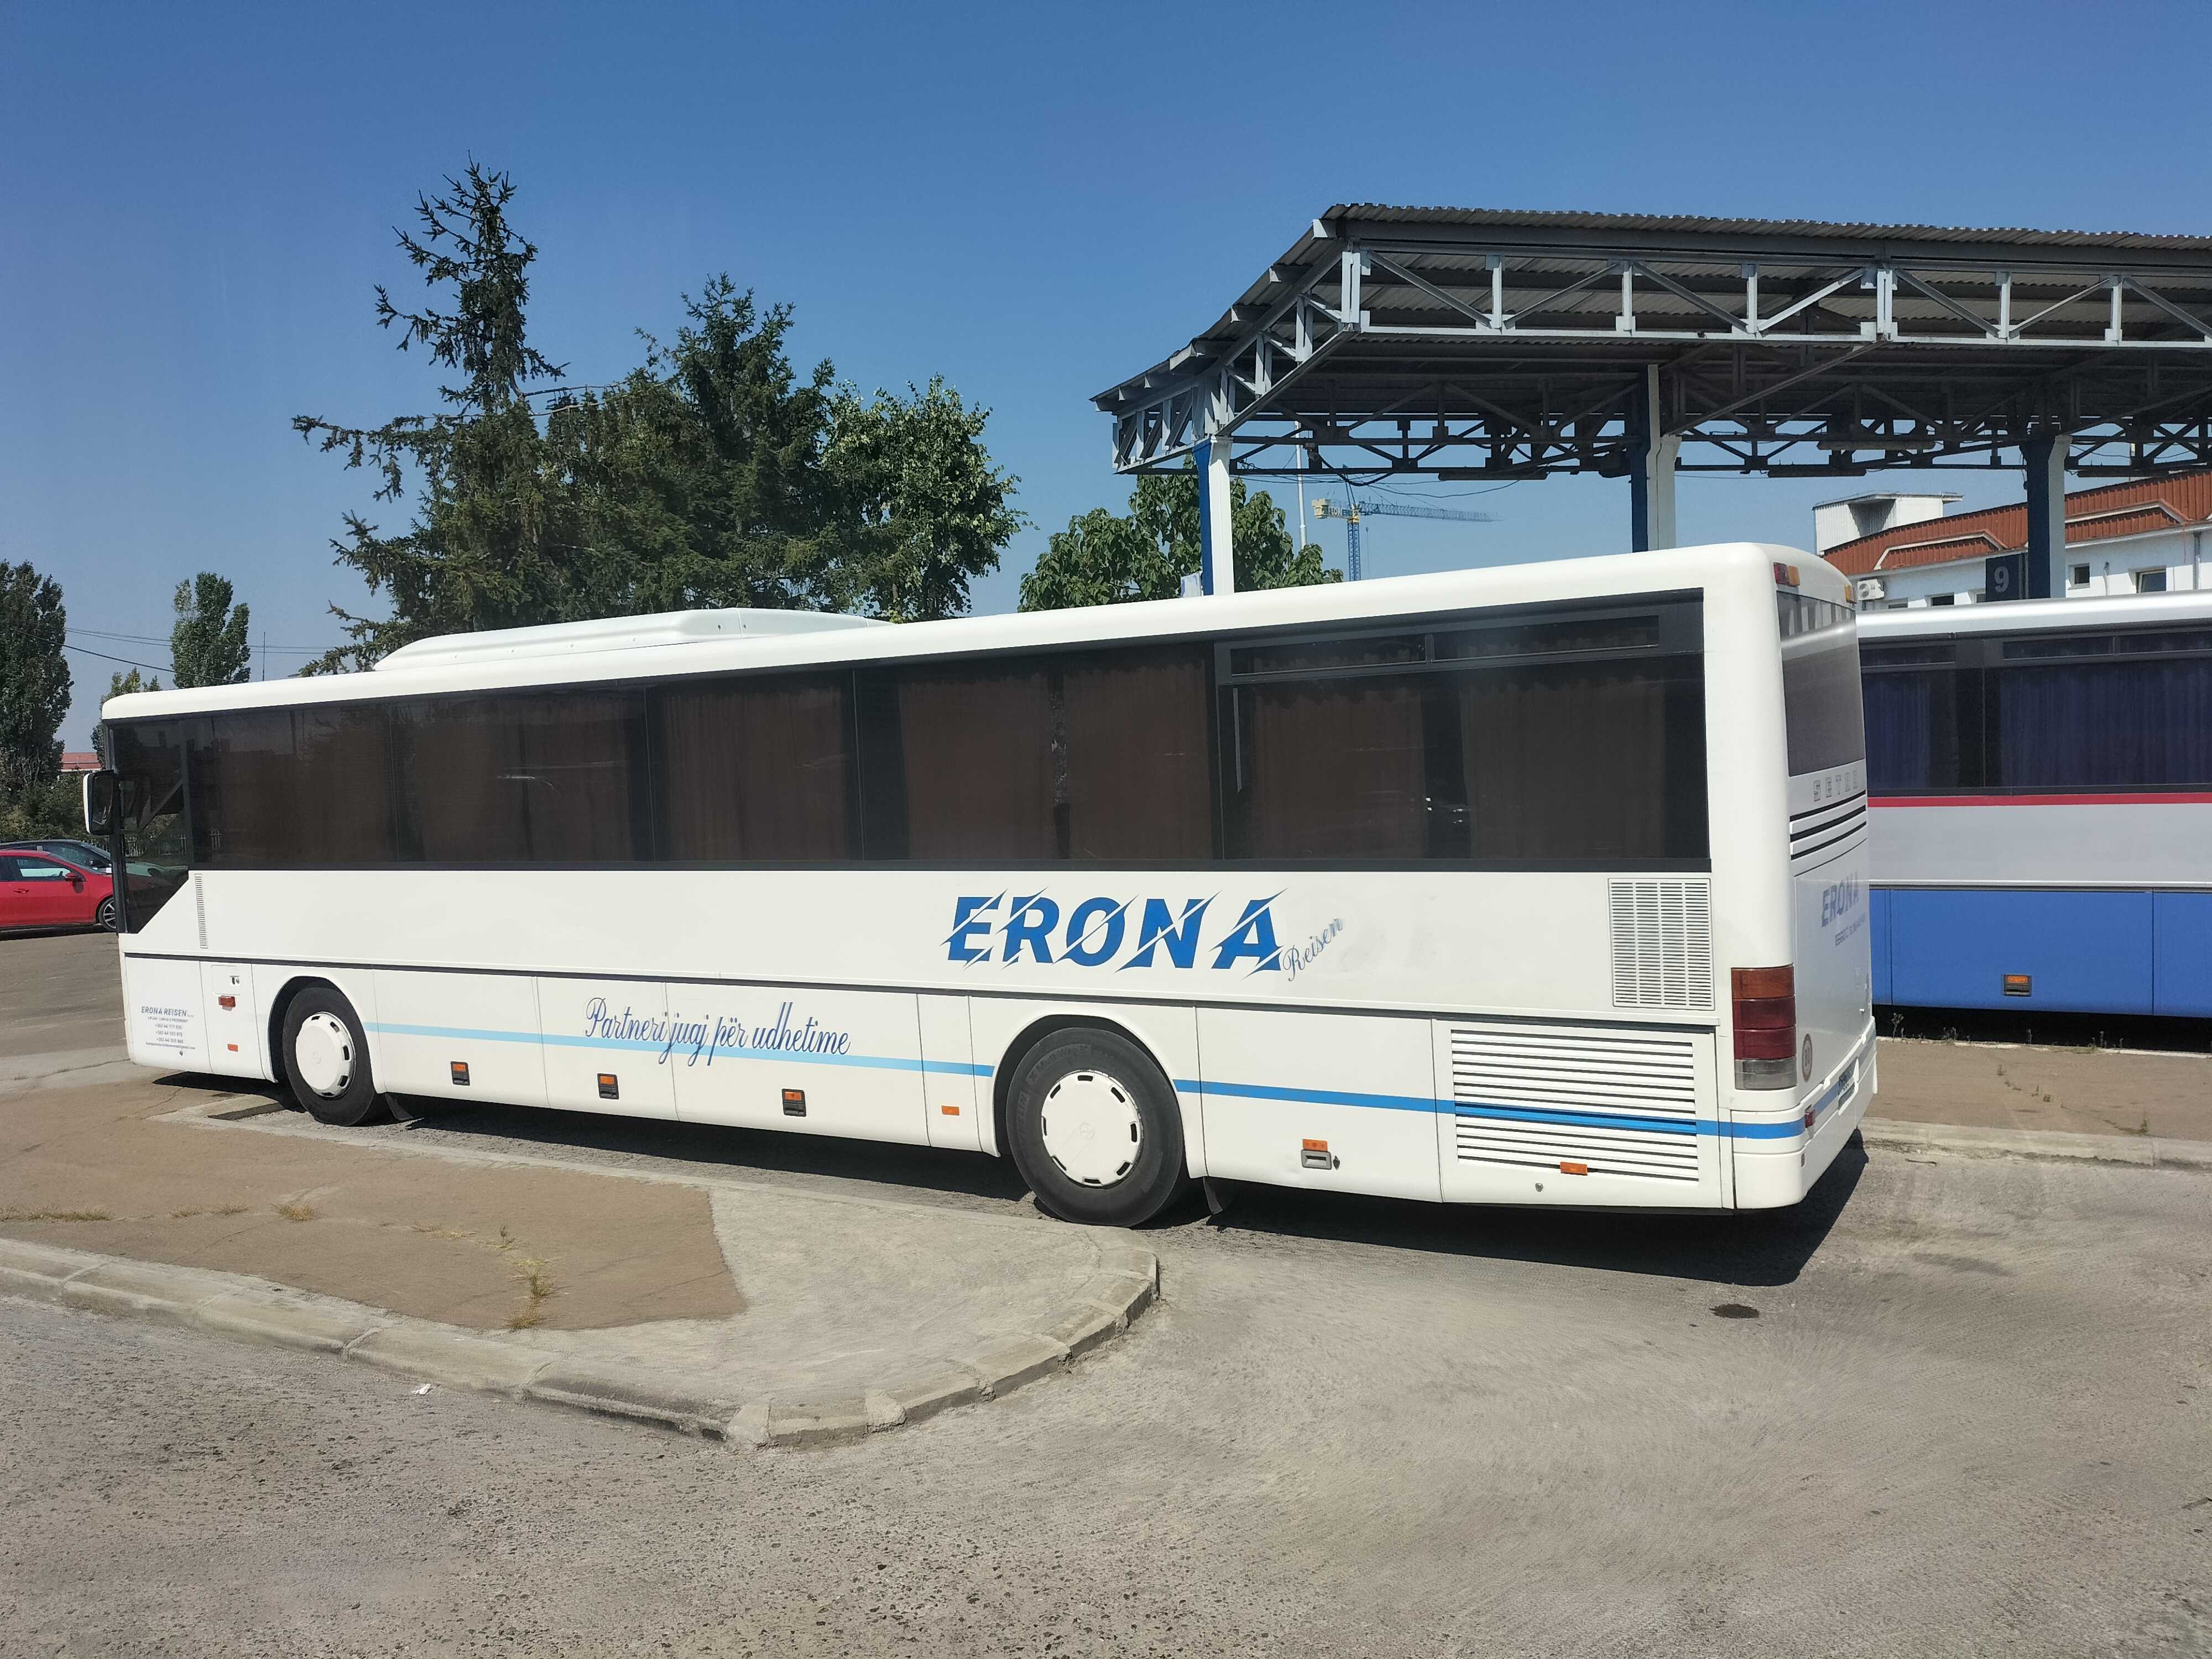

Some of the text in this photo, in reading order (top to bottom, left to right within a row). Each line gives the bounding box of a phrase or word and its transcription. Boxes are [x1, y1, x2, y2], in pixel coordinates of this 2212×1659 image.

[1994, 566, 2010, 593] 9
[940, 887, 1289, 979] ERONA
[1282, 917, 1346, 982] Reisen
[141, 1006, 187, 1017] ERONA REISEN
[585, 997, 667, 1042] Partneri
[706, 1016, 749, 1066] për
[751, 1001, 851, 1055] udhetime
